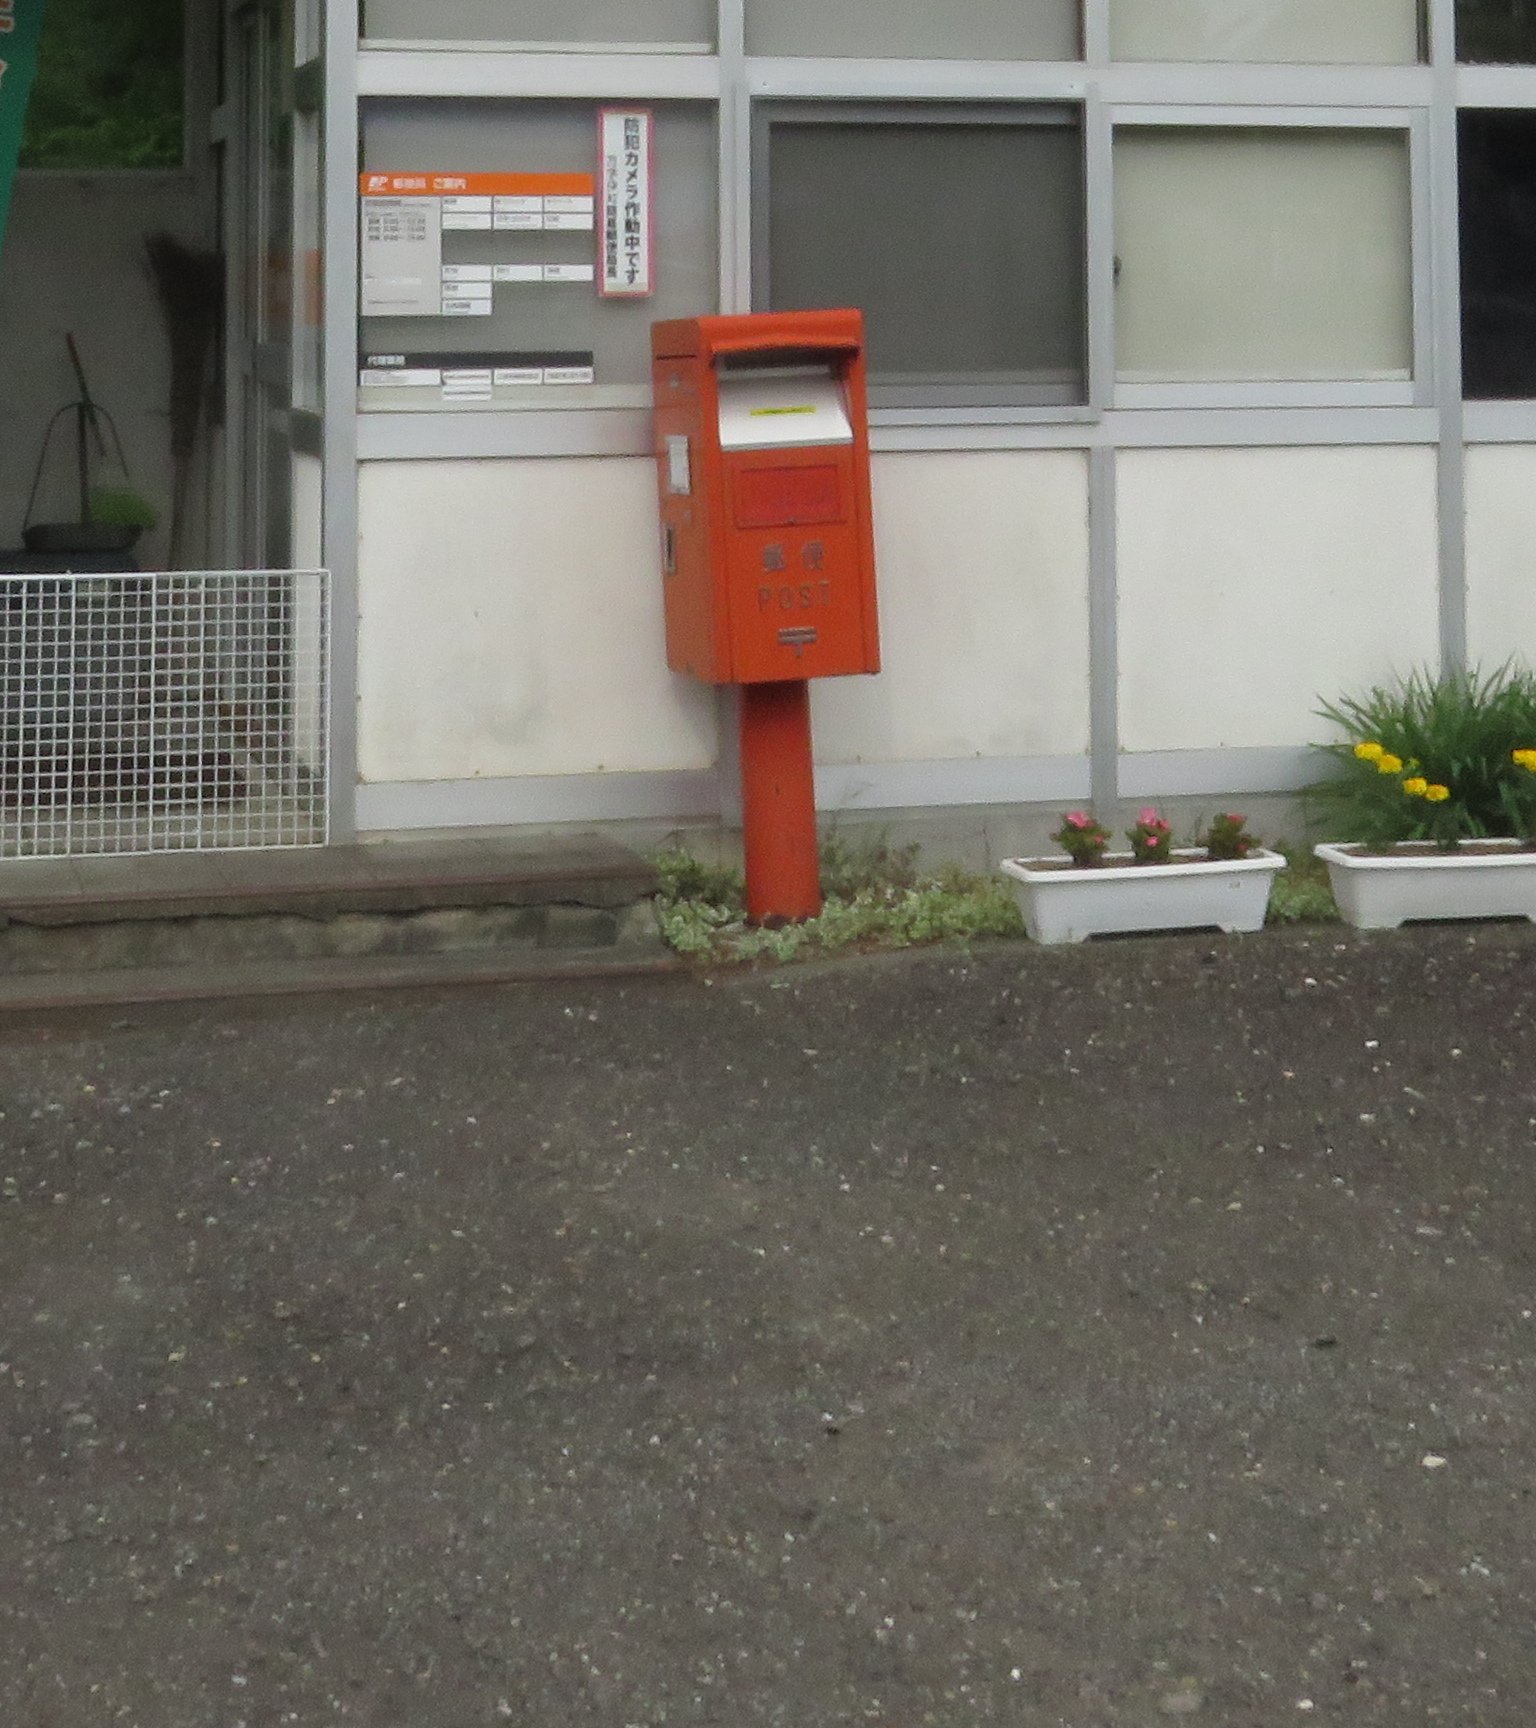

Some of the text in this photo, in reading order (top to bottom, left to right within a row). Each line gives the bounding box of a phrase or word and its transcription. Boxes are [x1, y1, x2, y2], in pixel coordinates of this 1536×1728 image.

[623, 117, 641, 285] 防犯カメラ作動中です
